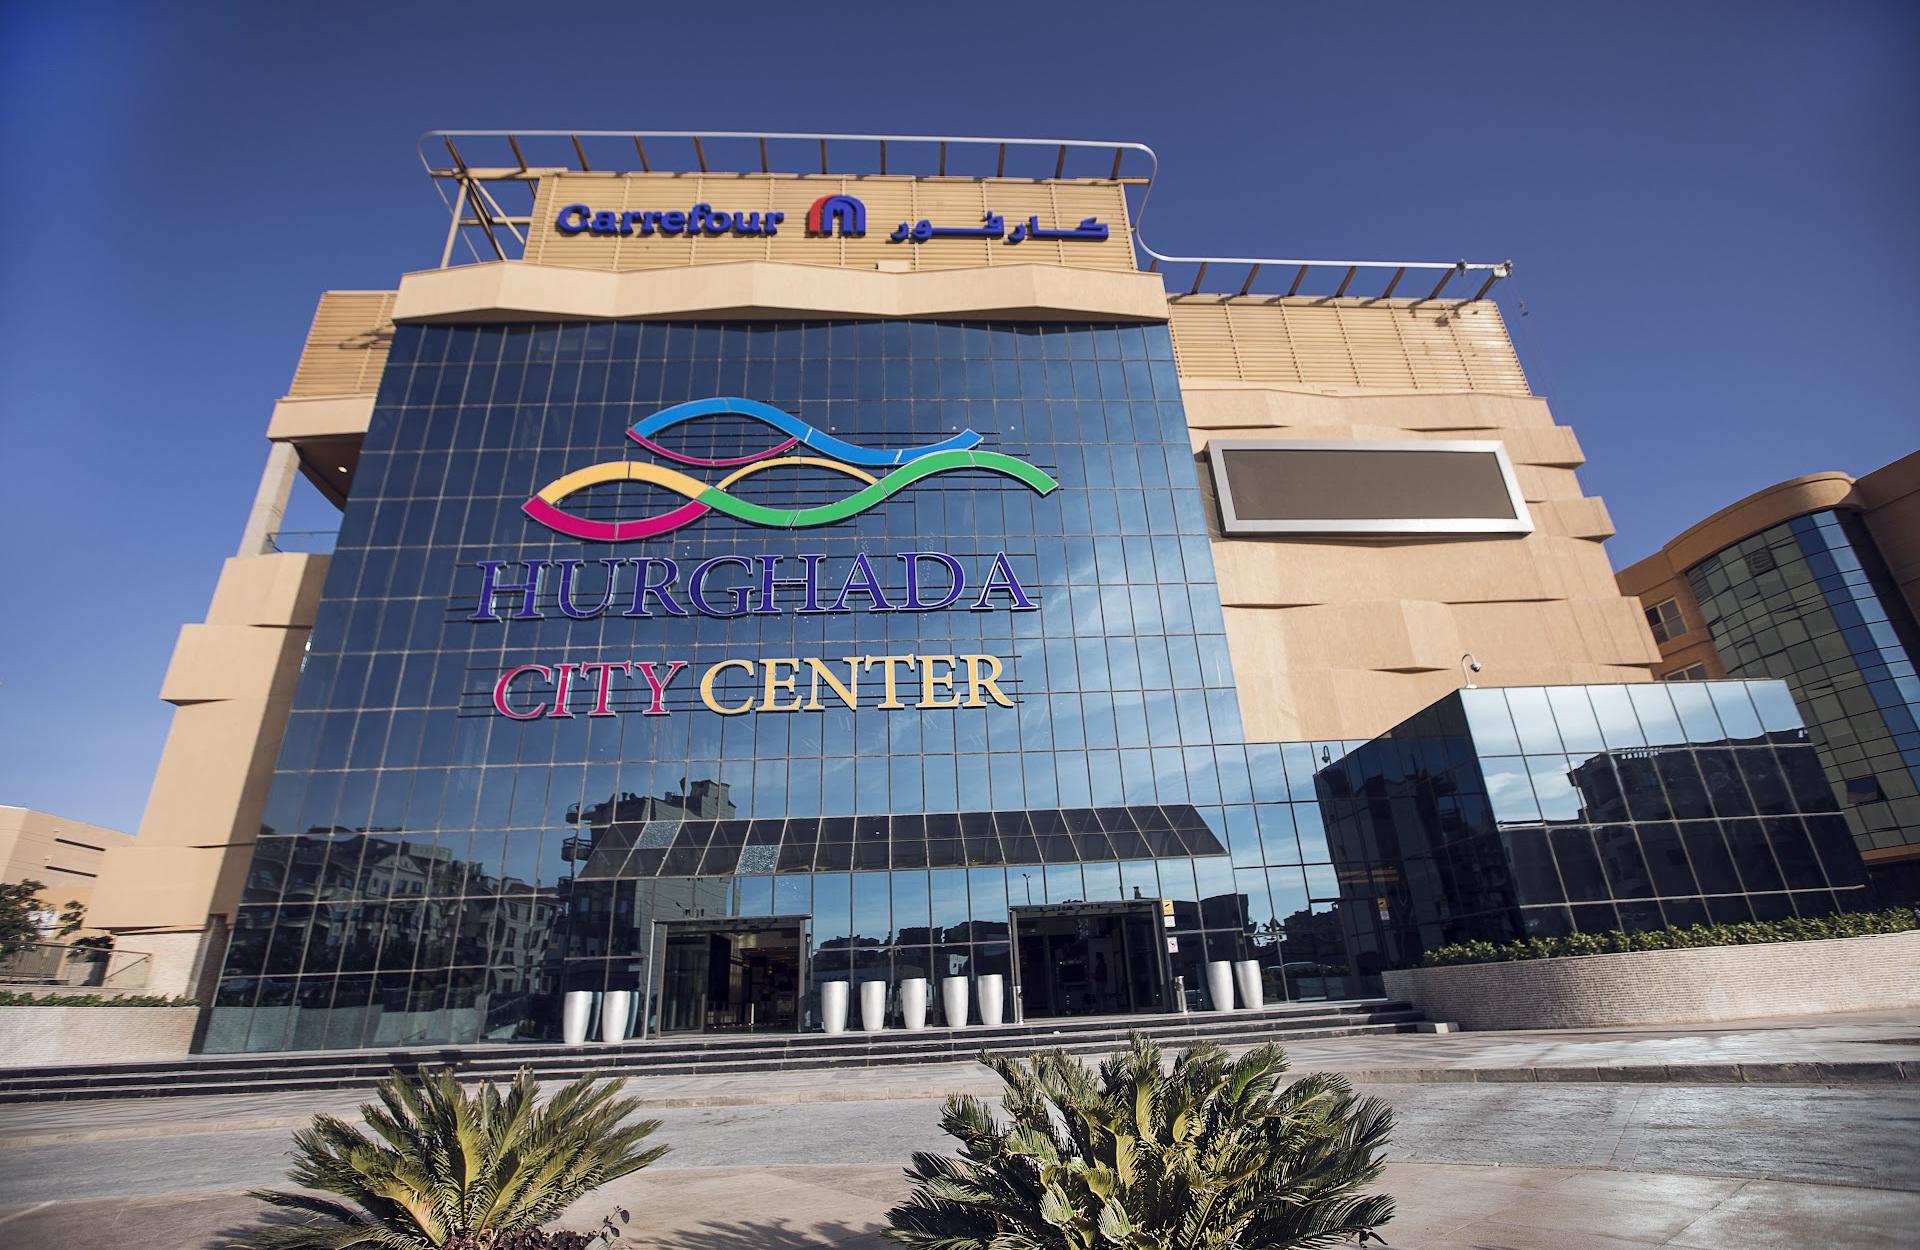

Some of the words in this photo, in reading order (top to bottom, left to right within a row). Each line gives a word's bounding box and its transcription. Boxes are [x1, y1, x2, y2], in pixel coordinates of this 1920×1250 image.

[557, 203, 783, 238] Carrefour
[889, 210, 1109, 242] كارفور
[468, 552, 1038, 622] HURGHADA
[493, 660, 688, 719] CITY
[700, 653, 1016, 715] CENTER
